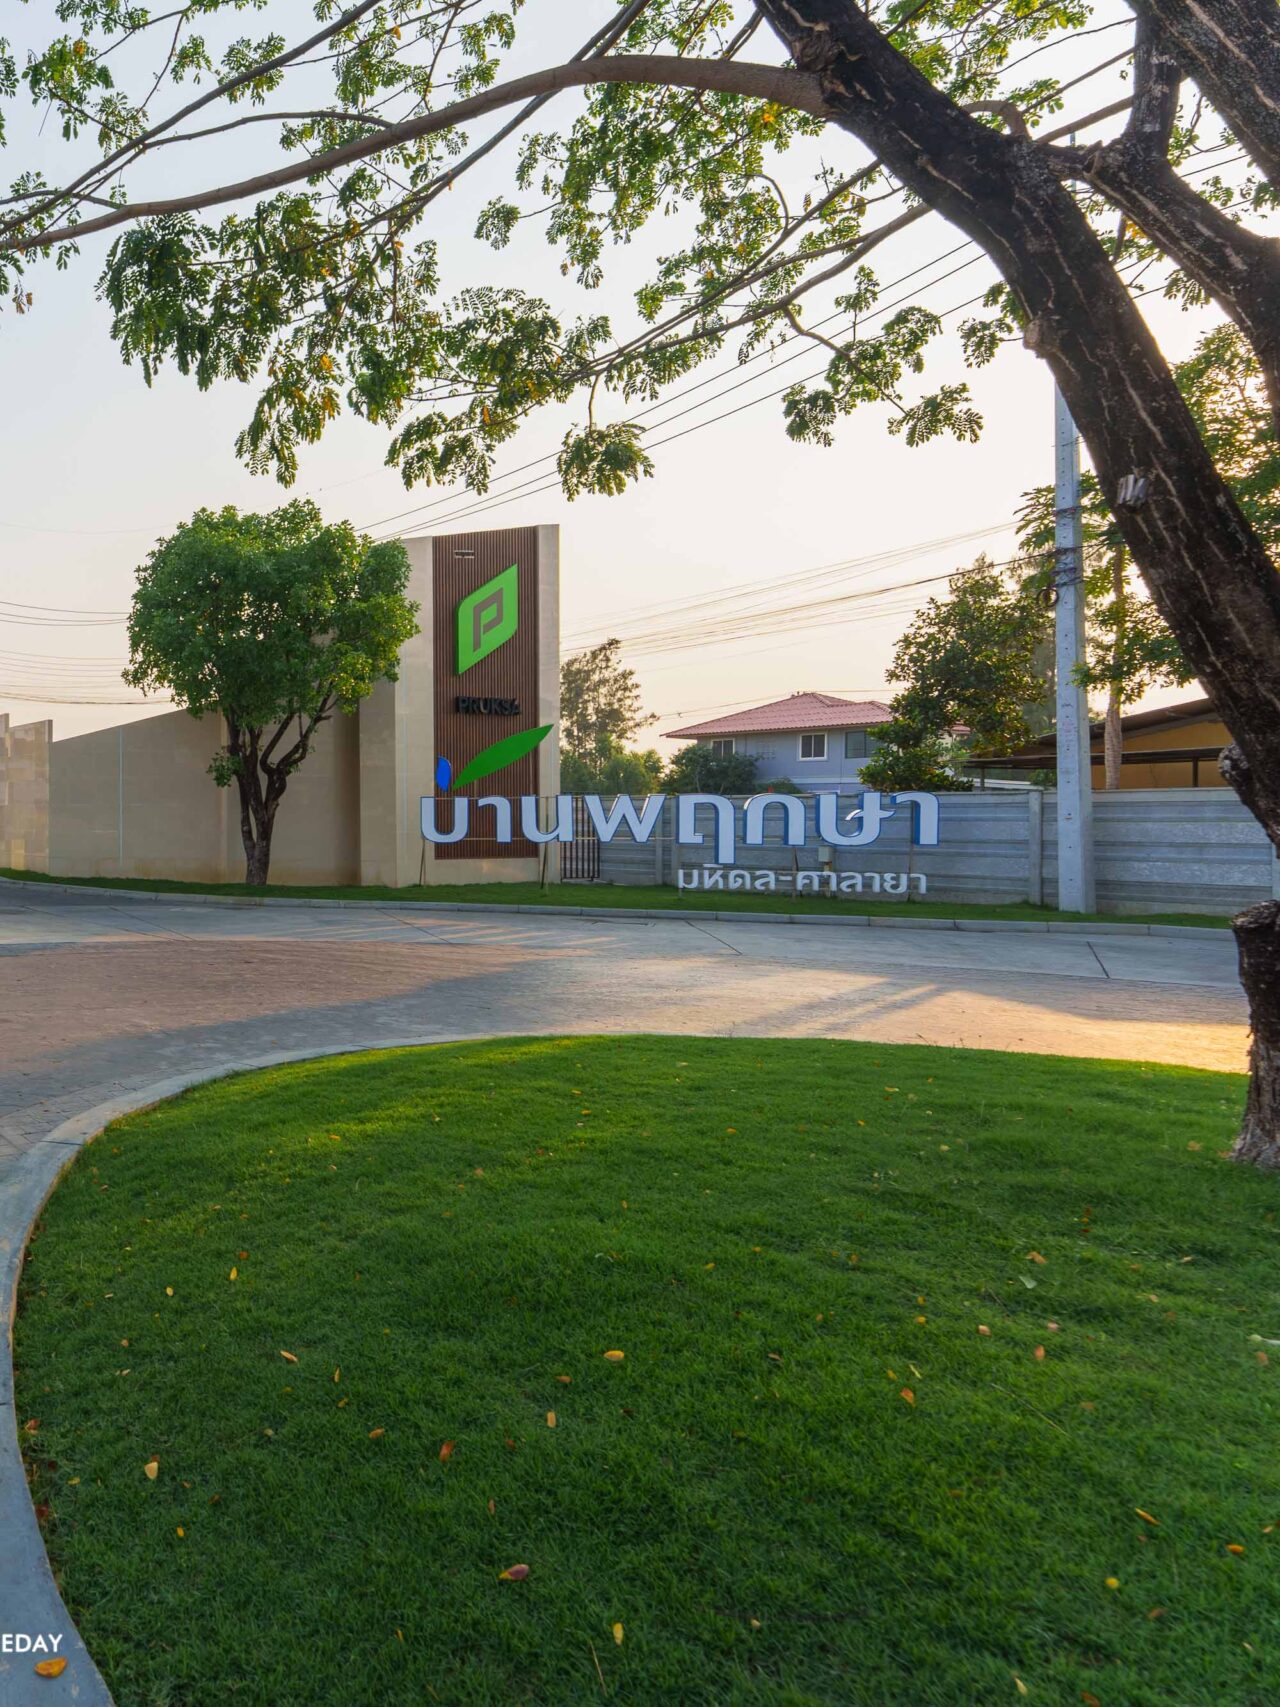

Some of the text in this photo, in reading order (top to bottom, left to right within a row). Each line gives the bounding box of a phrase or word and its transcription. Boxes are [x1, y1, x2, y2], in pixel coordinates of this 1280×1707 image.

[456, 696, 521, 716] PRUKSA
[677, 863, 927, 894] มหิดล-ศาลายา
